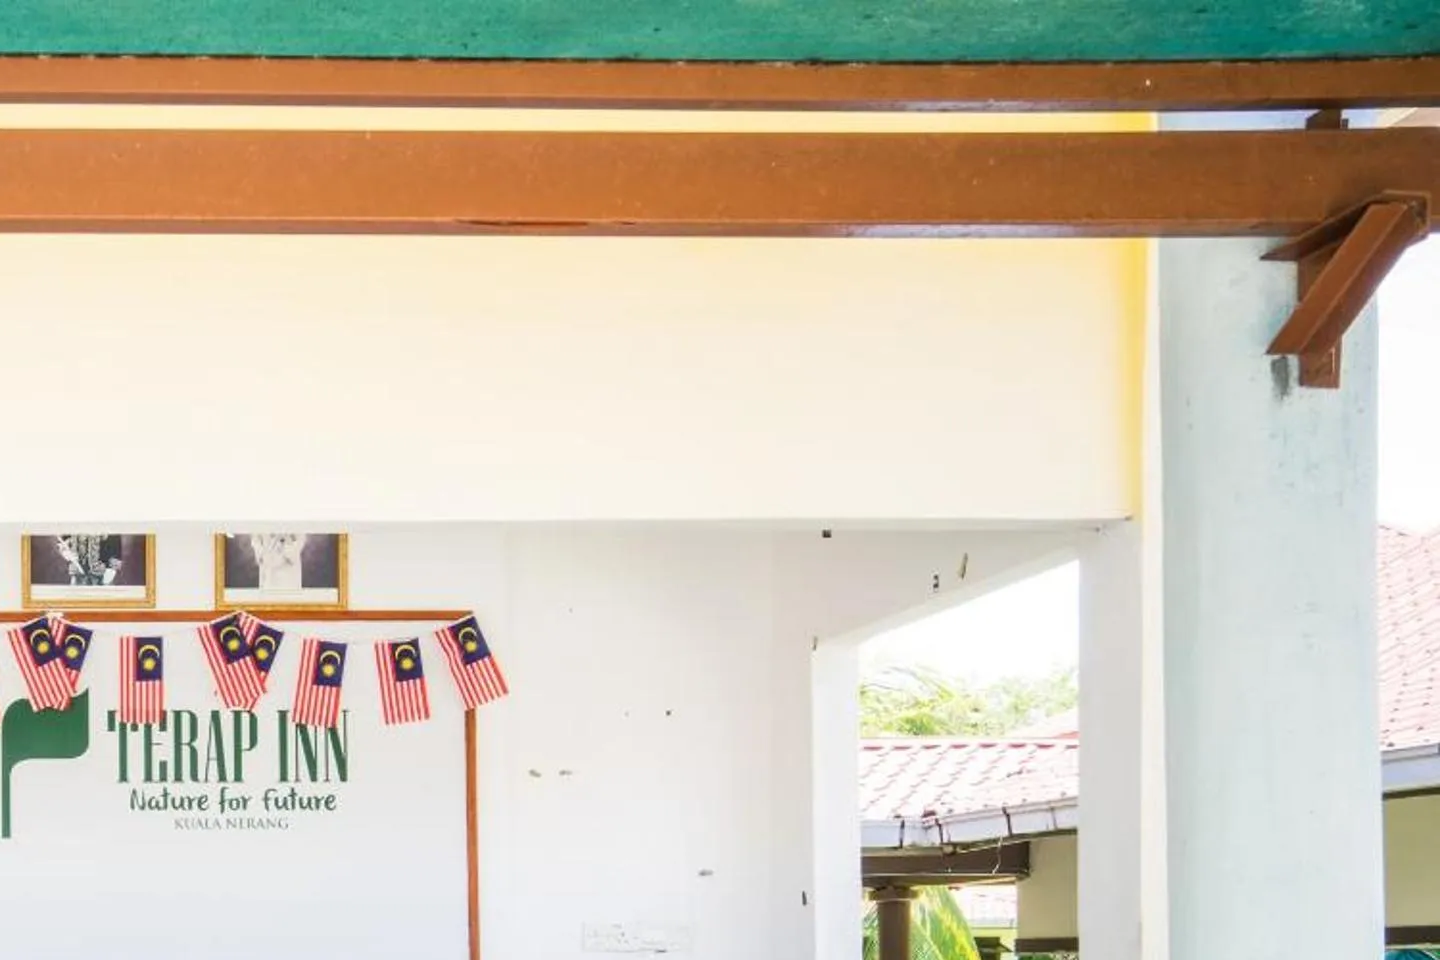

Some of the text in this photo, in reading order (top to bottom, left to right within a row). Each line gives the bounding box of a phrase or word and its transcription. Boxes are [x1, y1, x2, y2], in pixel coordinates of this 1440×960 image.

[107, 709, 352, 783] TERAP INN
[129, 786, 208, 811] Nature
[218, 786, 252, 814] for
[174, 817, 289, 831] KUALA NERANG
